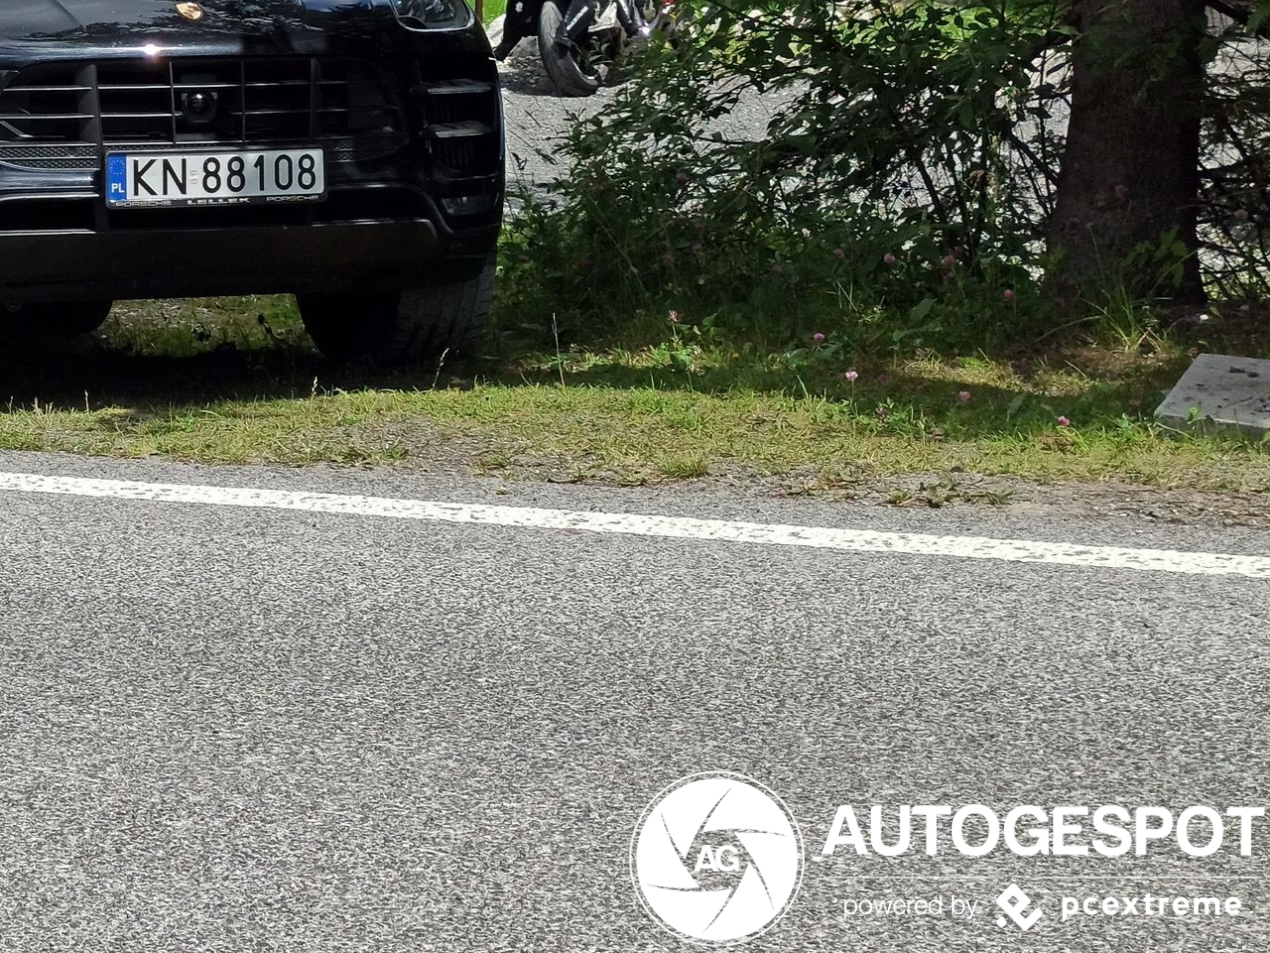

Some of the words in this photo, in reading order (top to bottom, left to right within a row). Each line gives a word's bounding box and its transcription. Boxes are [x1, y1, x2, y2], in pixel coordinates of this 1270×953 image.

[111, 182, 126, 194] PL
[132, 157, 187, 196] KN
[202, 153, 317, 194] 88108
